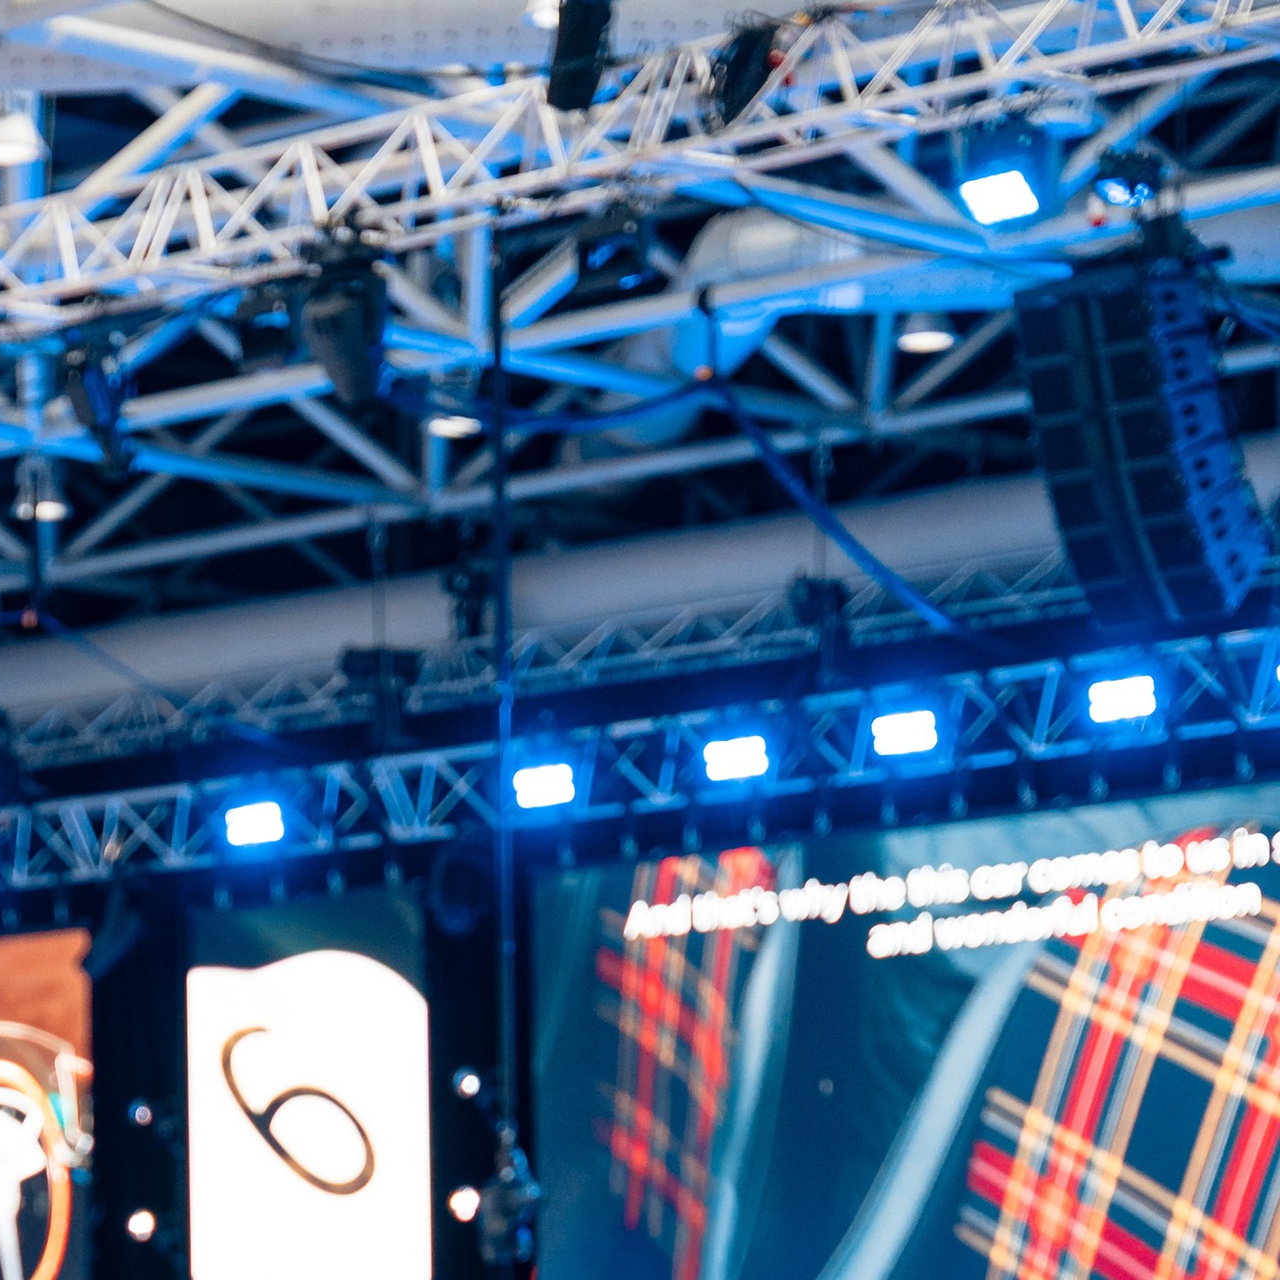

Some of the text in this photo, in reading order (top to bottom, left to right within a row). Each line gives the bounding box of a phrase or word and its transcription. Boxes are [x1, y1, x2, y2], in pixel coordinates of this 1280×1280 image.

[623, 893, 691, 941] And
[779, 878, 849, 924] why
[849, 871, 907, 915] the
